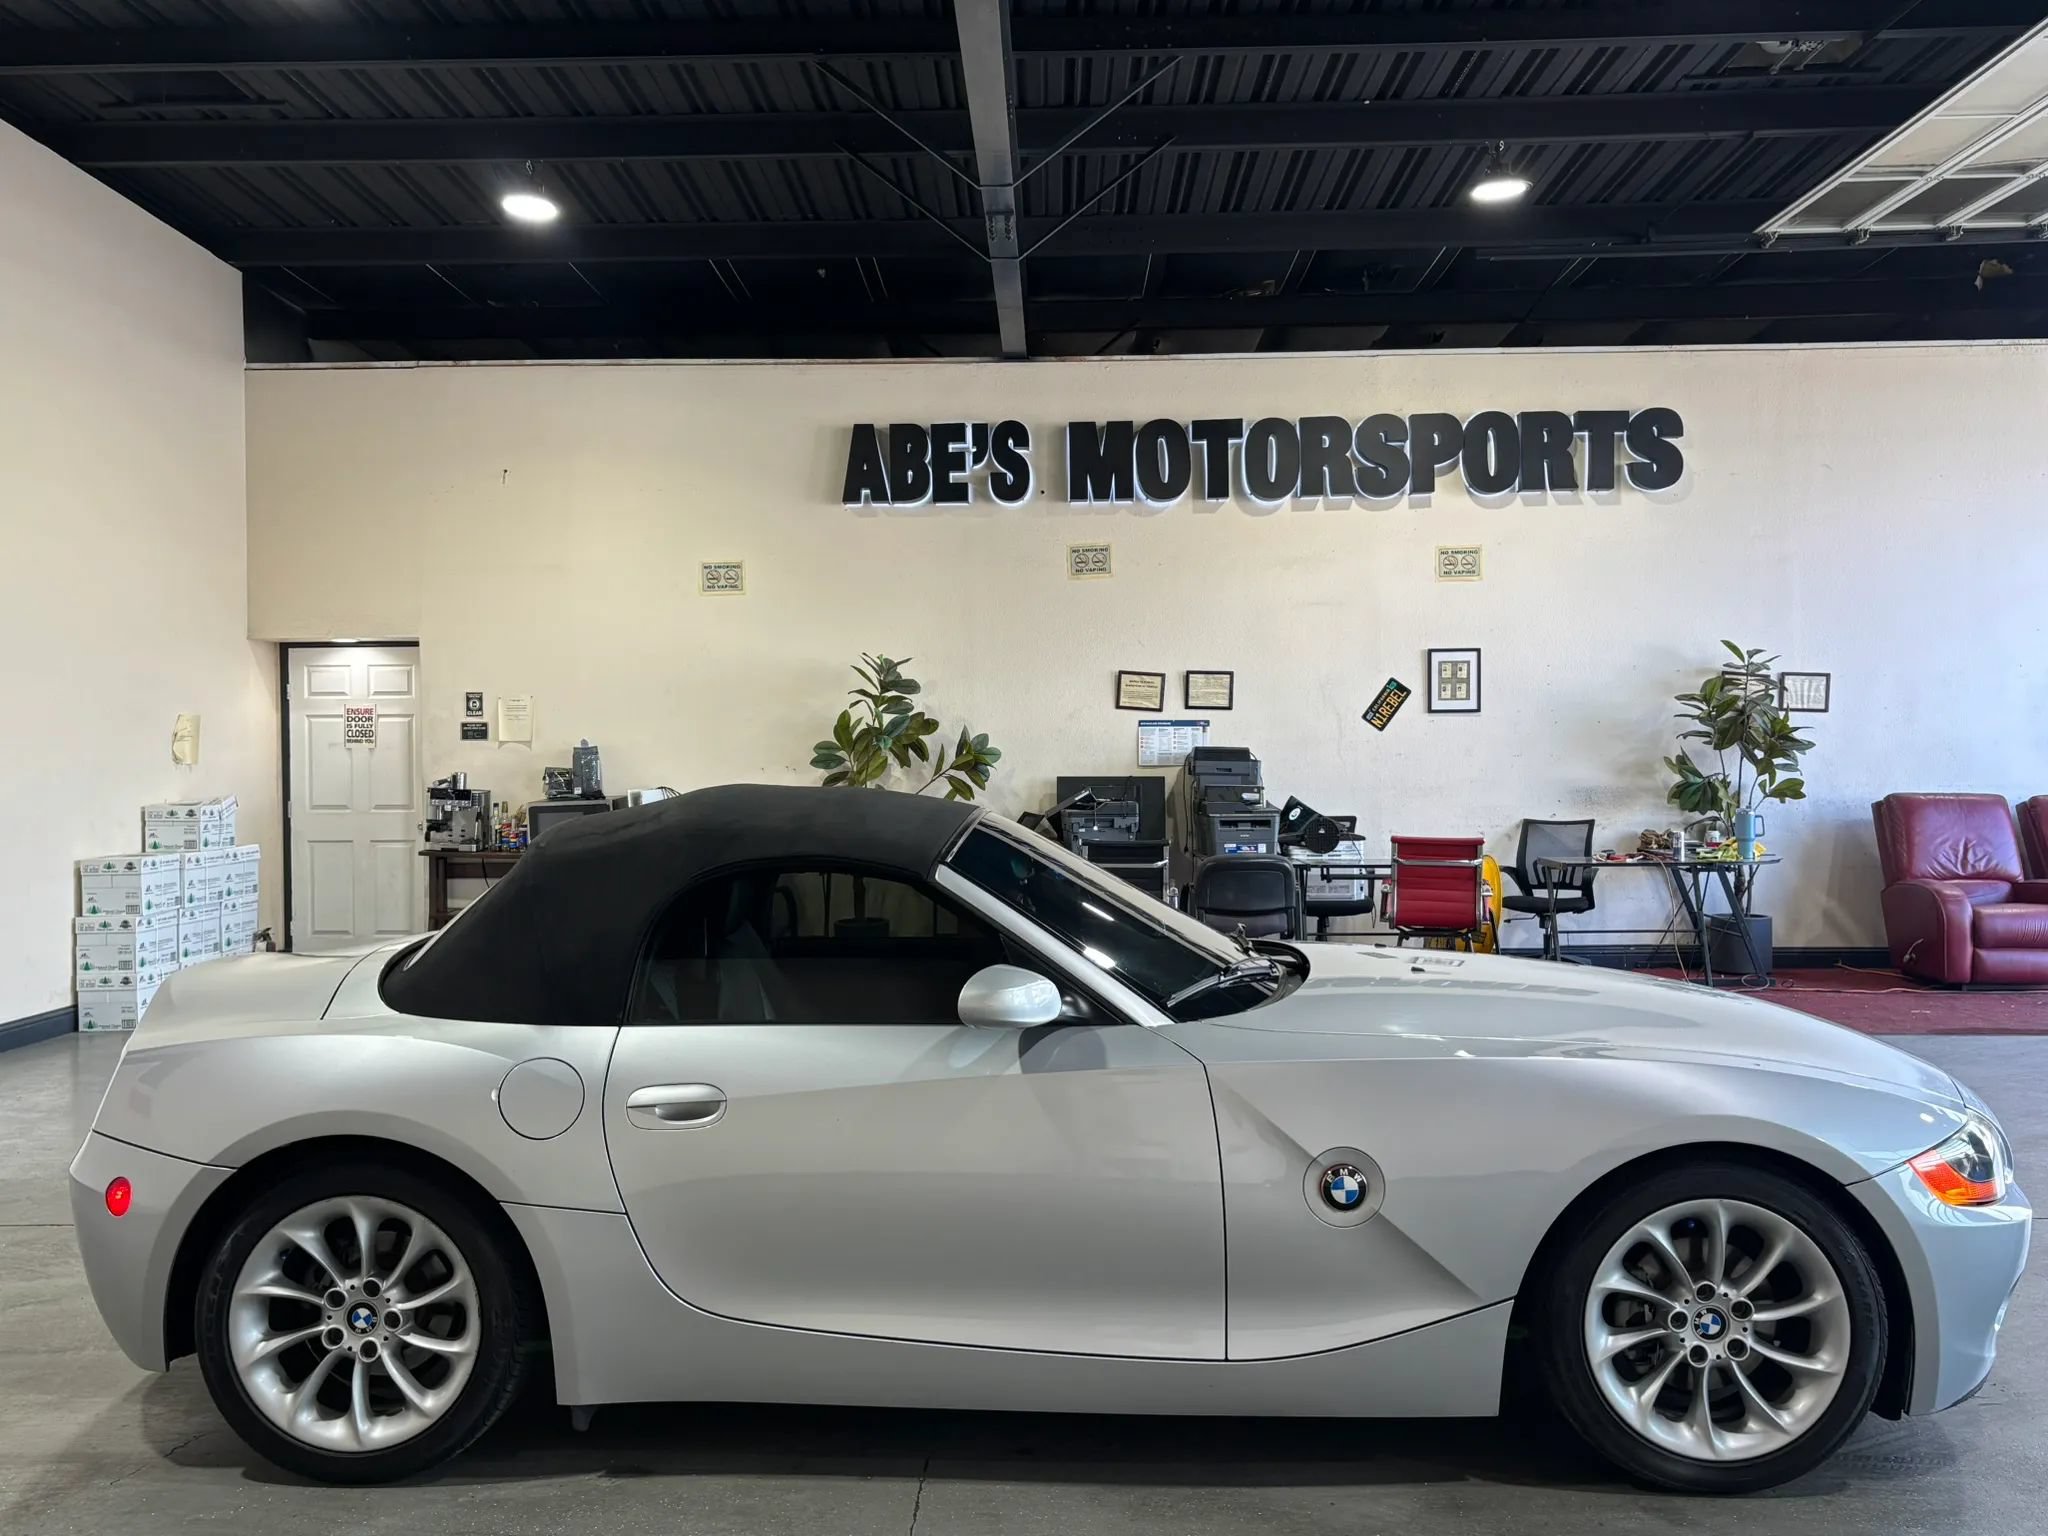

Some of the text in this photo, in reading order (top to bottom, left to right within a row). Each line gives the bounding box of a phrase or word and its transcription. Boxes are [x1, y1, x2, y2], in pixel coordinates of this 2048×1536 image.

[842, 407, 1685, 505] ABE'S MOTORSPORTS
[347, 729, 374, 737] CLOSED
[1326, 1168, 1362, 1183] BMW
